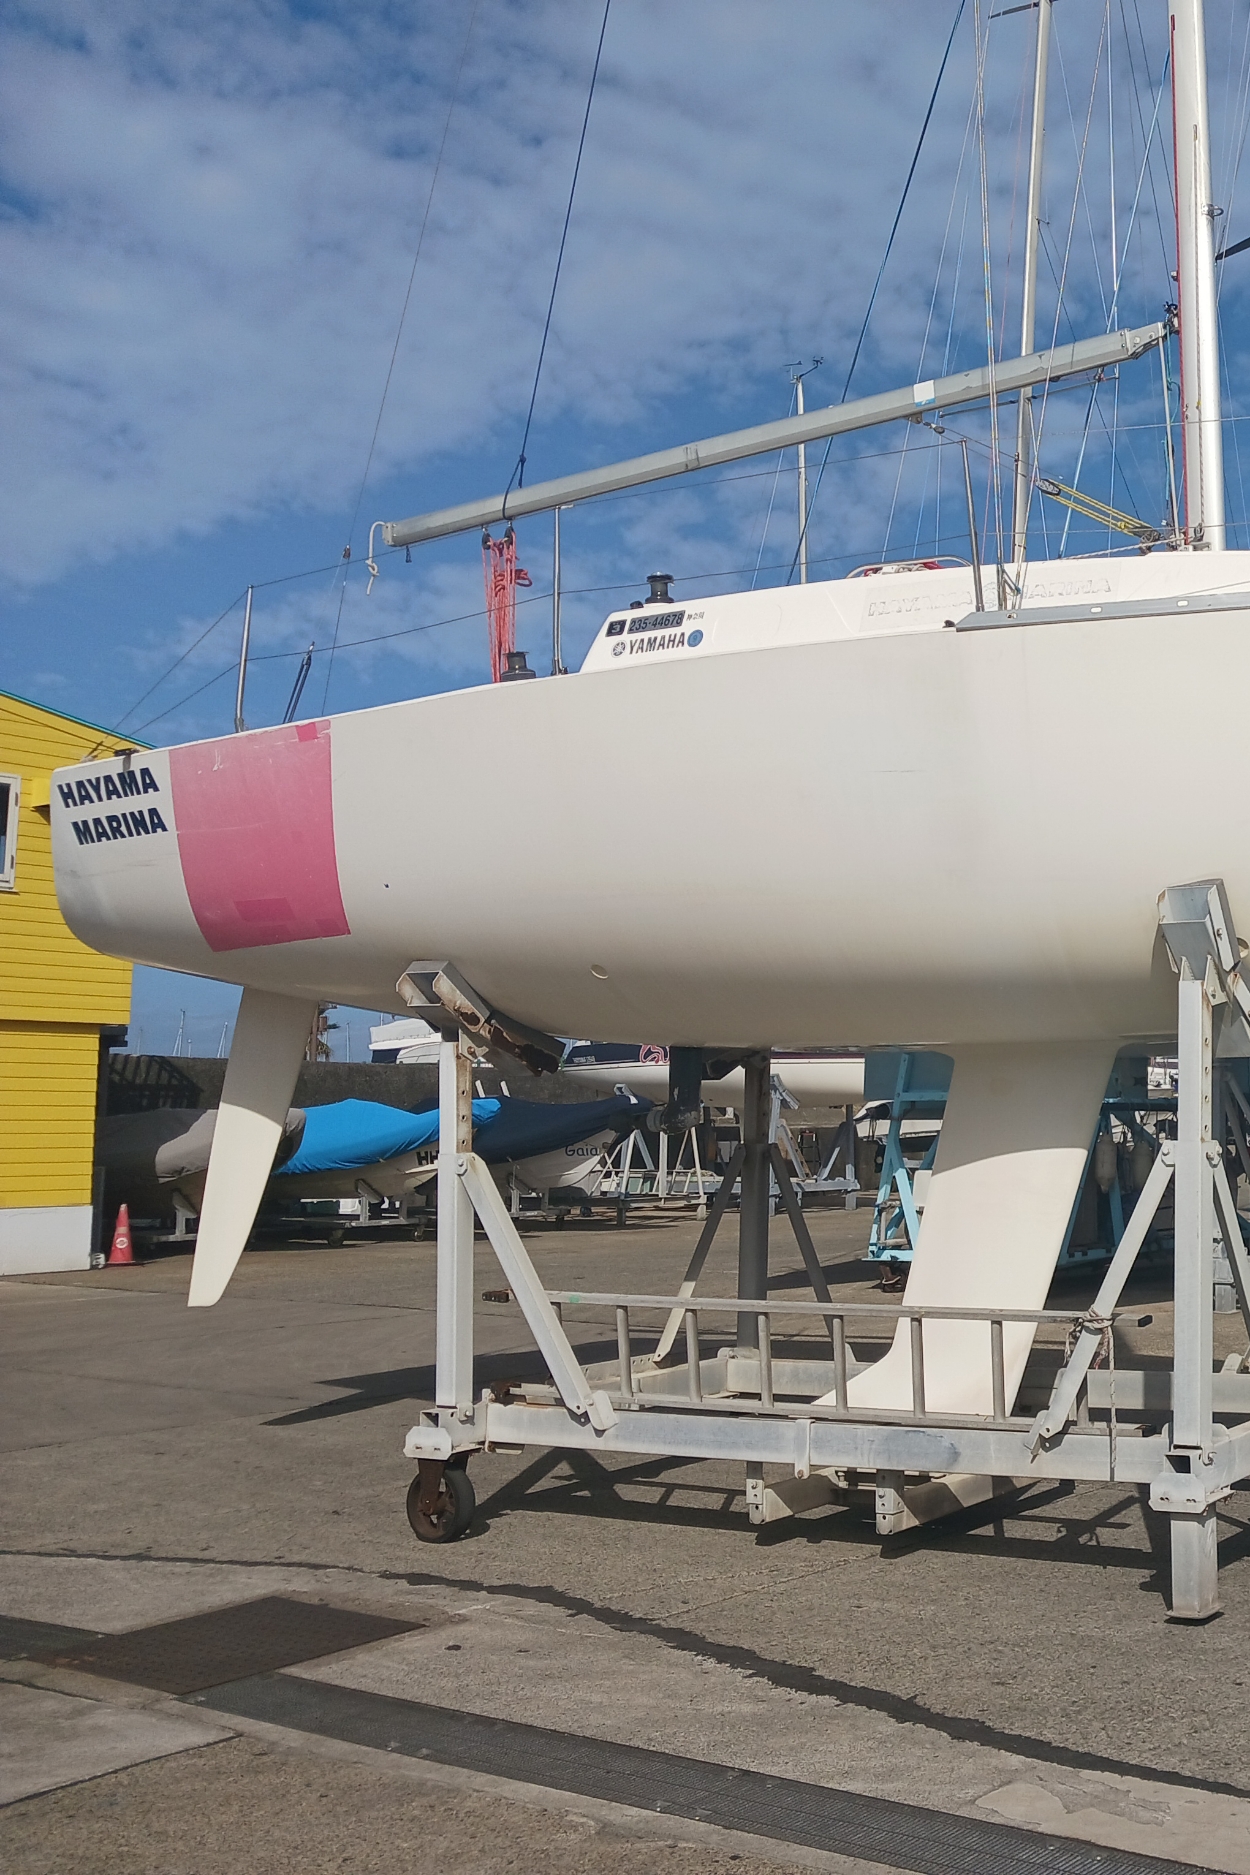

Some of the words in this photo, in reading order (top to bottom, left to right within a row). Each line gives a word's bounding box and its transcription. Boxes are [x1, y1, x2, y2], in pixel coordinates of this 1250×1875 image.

[629, 632, 686, 655] YAMAHA
[57, 767, 160, 808] HAYAMA
[71, 807, 169, 846] MARINA
[565, 1145, 600, 1157] Gaia
